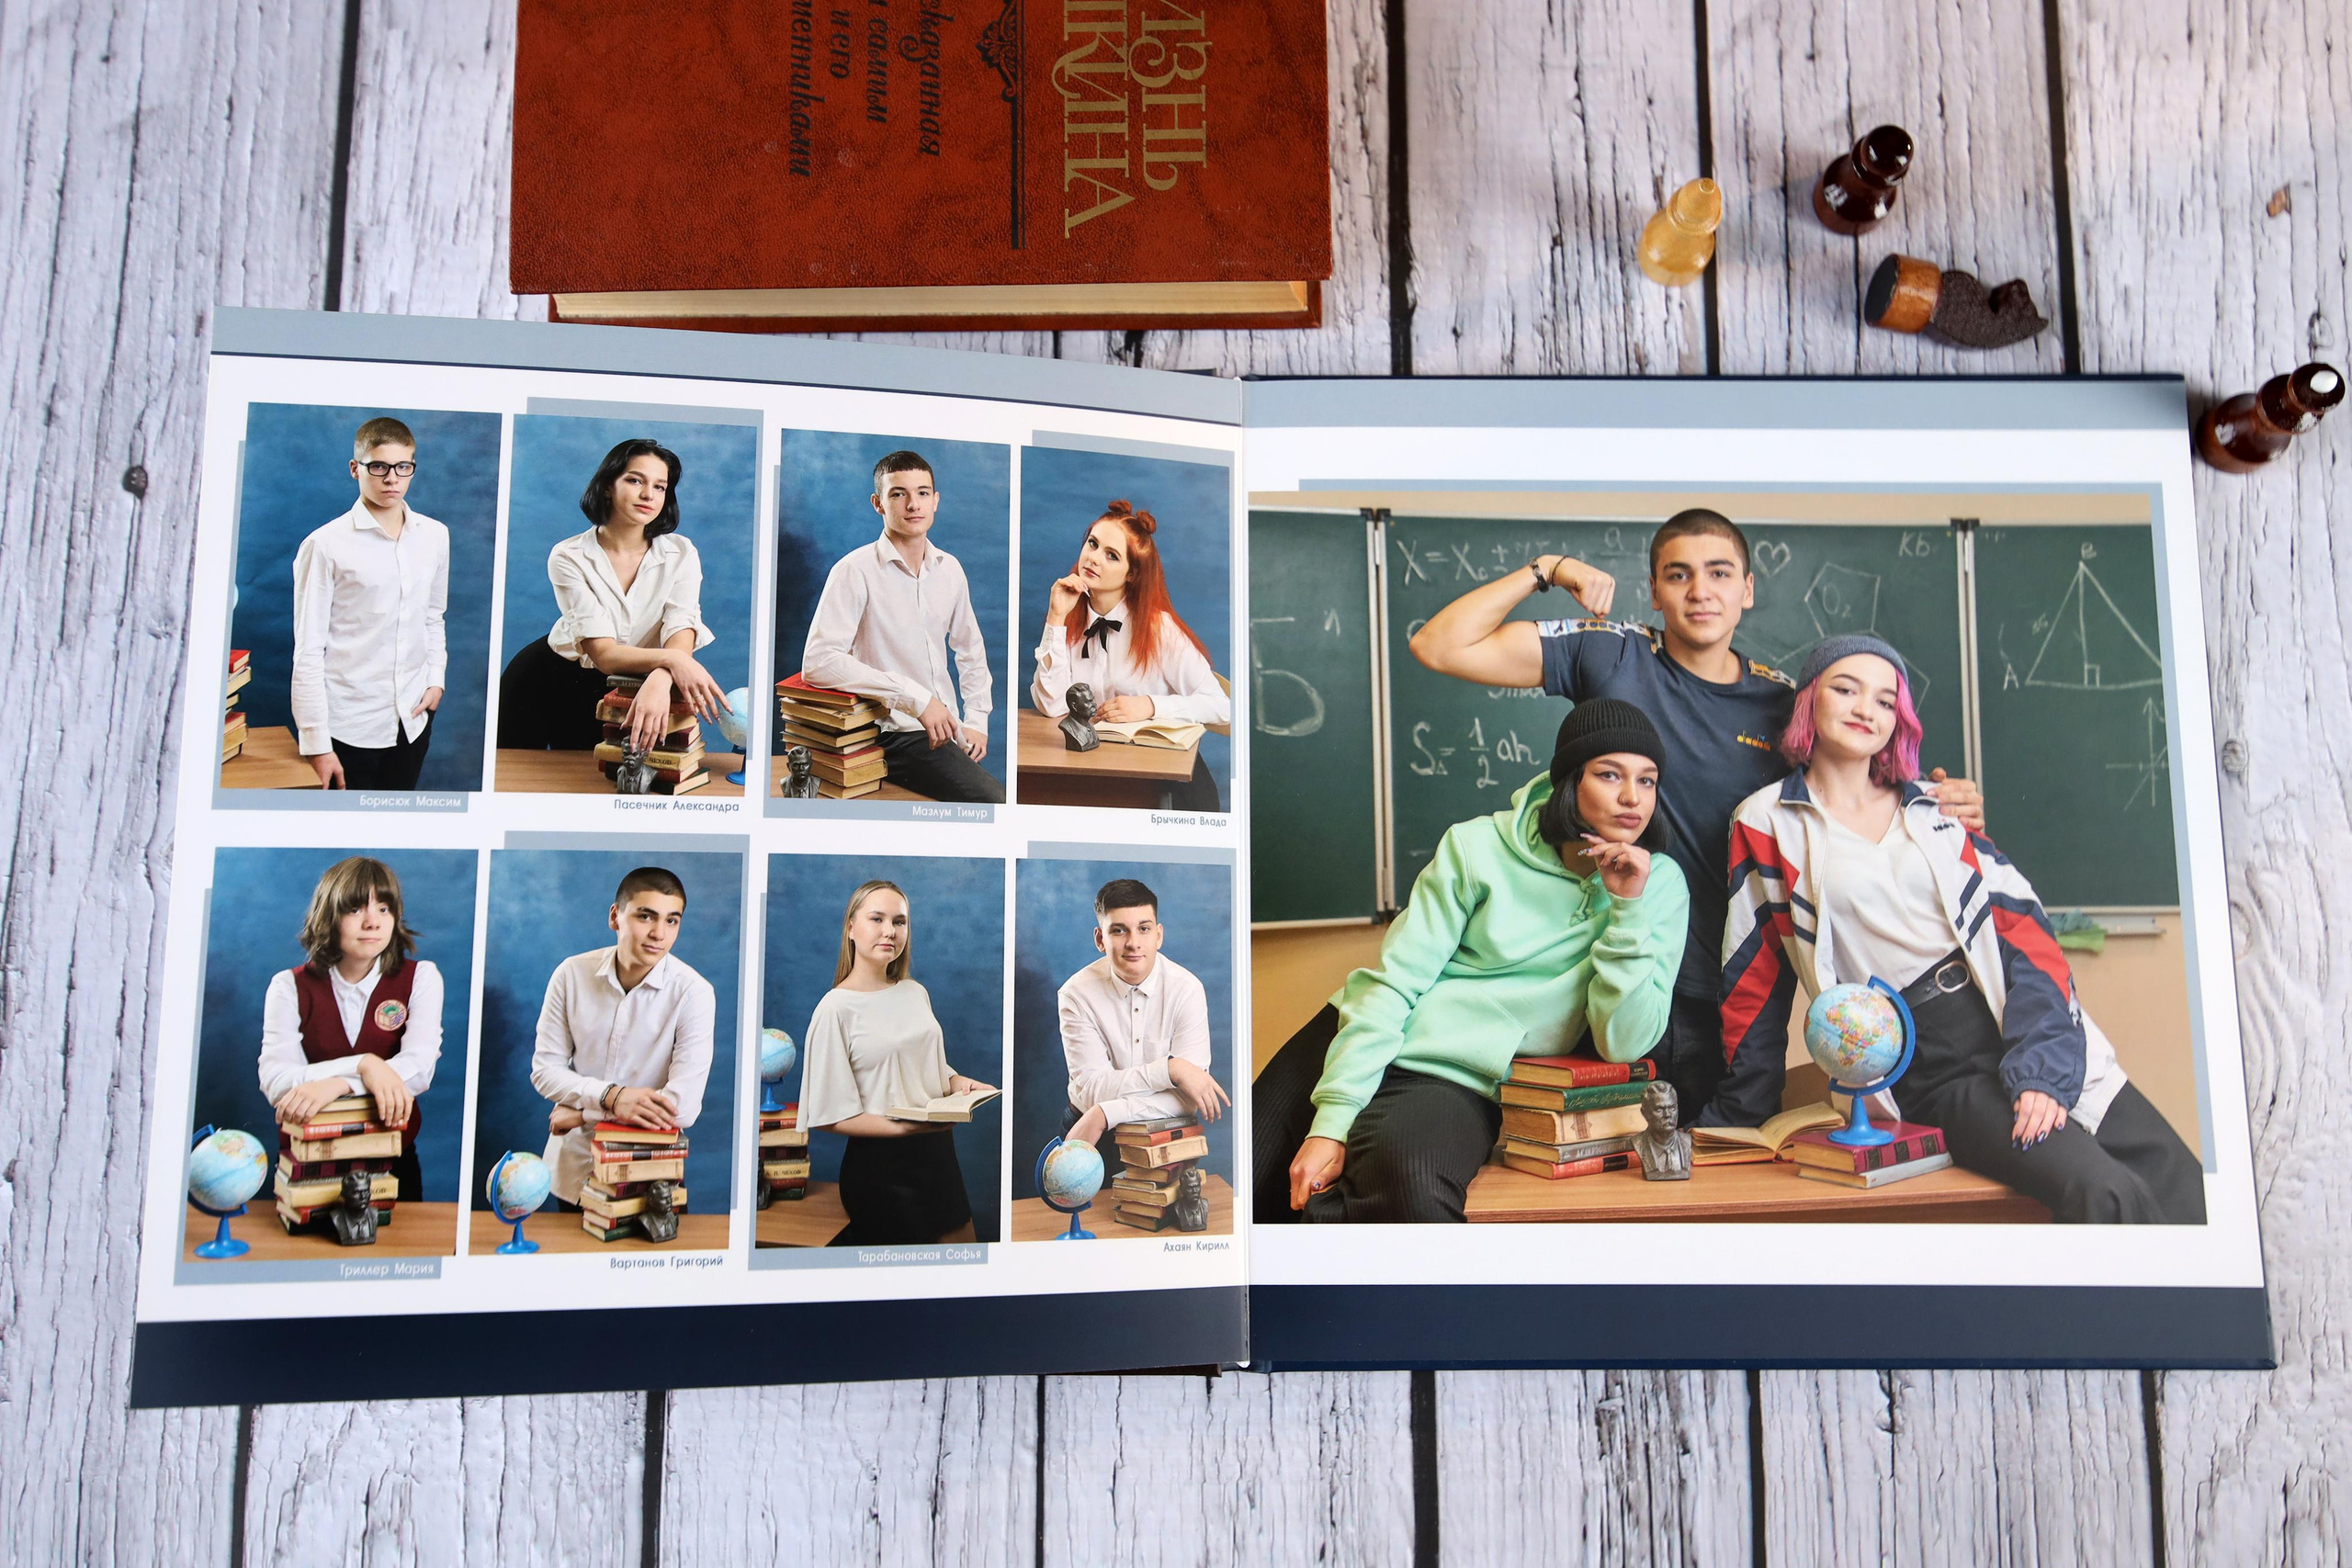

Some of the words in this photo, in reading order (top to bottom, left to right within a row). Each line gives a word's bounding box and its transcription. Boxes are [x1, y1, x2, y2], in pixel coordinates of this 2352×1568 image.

[830, 32, 853, 81] его
[866, 18, 890, 125] самим
[359, 795, 411, 808] Борисюк
[415, 795, 461, 807] Максим
[614, 798, 668, 810] Пасечник
[673, 800, 740, 813] Александра
[912, 805, 952, 819] Мазлум
[956, 807, 988, 820] Тимур
[1150, 813, 1195, 826] Брычкина
[1199, 816, 1227, 827] Влада
[1163, 1242, 1192, 1252] Ахаян
[1196, 1240, 1230, 1253] Кирилл
[610, 1257, 665, 1270] Вартанов
[670, 1255, 723, 1269] Григорий
[858, 1249, 941, 1264] Тарабановская
[945, 1247, 981, 1262] Софья
[394, 1262, 435, 1277] Мария
